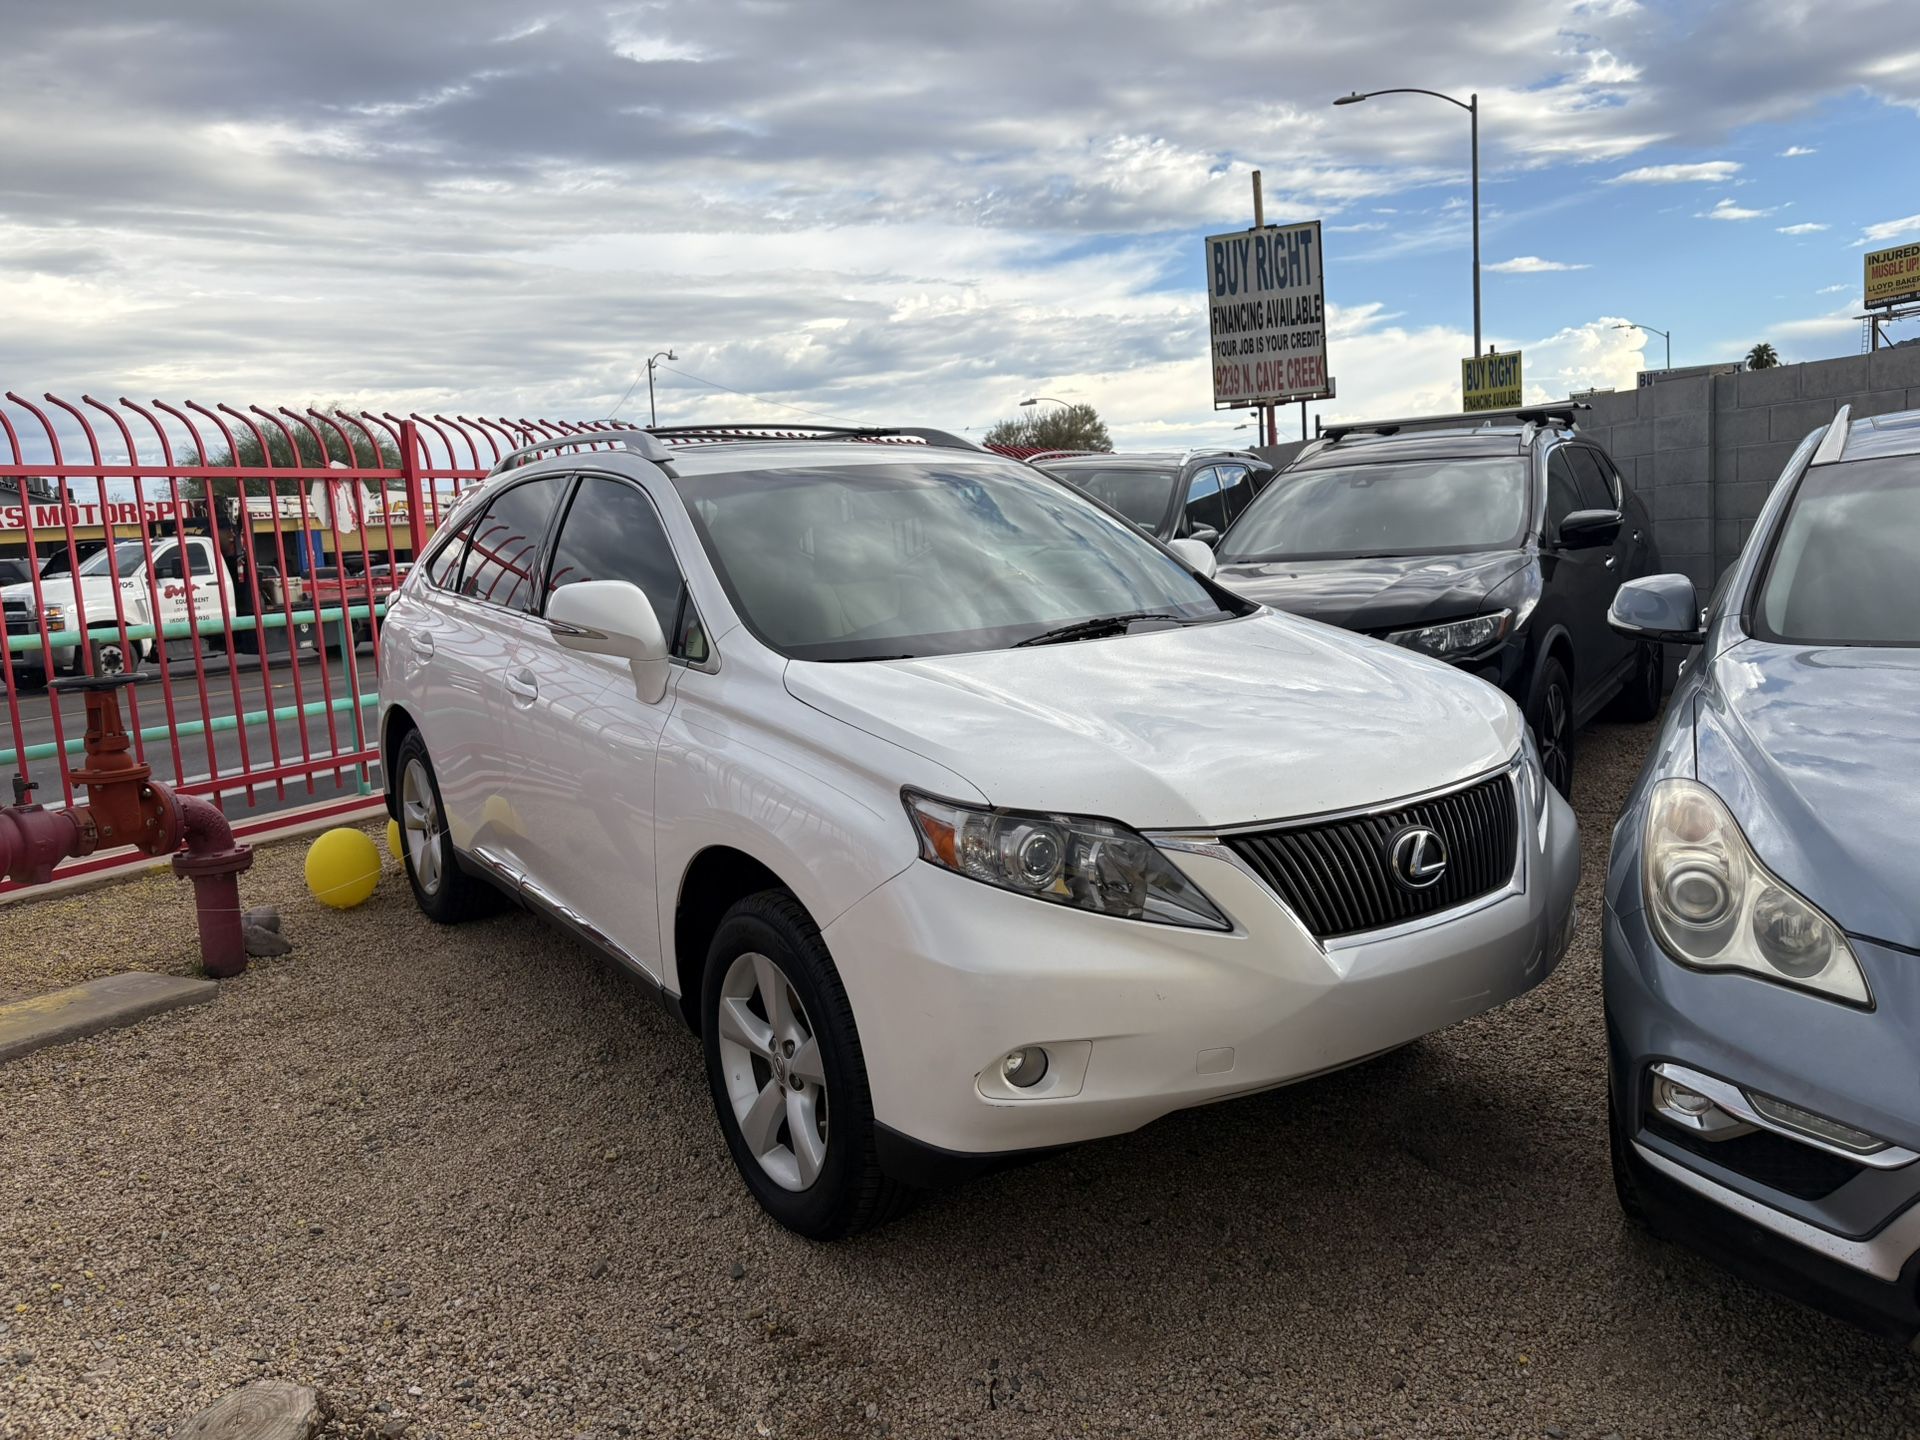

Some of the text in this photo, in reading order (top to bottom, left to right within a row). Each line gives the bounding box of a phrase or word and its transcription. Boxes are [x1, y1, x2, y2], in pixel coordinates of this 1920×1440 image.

[1213, 229, 1312, 297] BUY RIGHT
[1868, 246, 1920, 265] INJURED
[1871, 256, 1919, 280] MUSCLE UP!
[1868, 281, 1894, 292] LLOYD
[1212, 294, 1321, 335] FINANCING AVAILABLE
[1216, 330, 1320, 357] YOUR JOB IS YOUR CREDIT
[1216, 355, 1324, 396] 9239 N. CAVE CREEK
[1466, 356, 1517, 391] BUY RIGHT
[1464, 389, 1521, 411] FINANCING AVAILABLE
